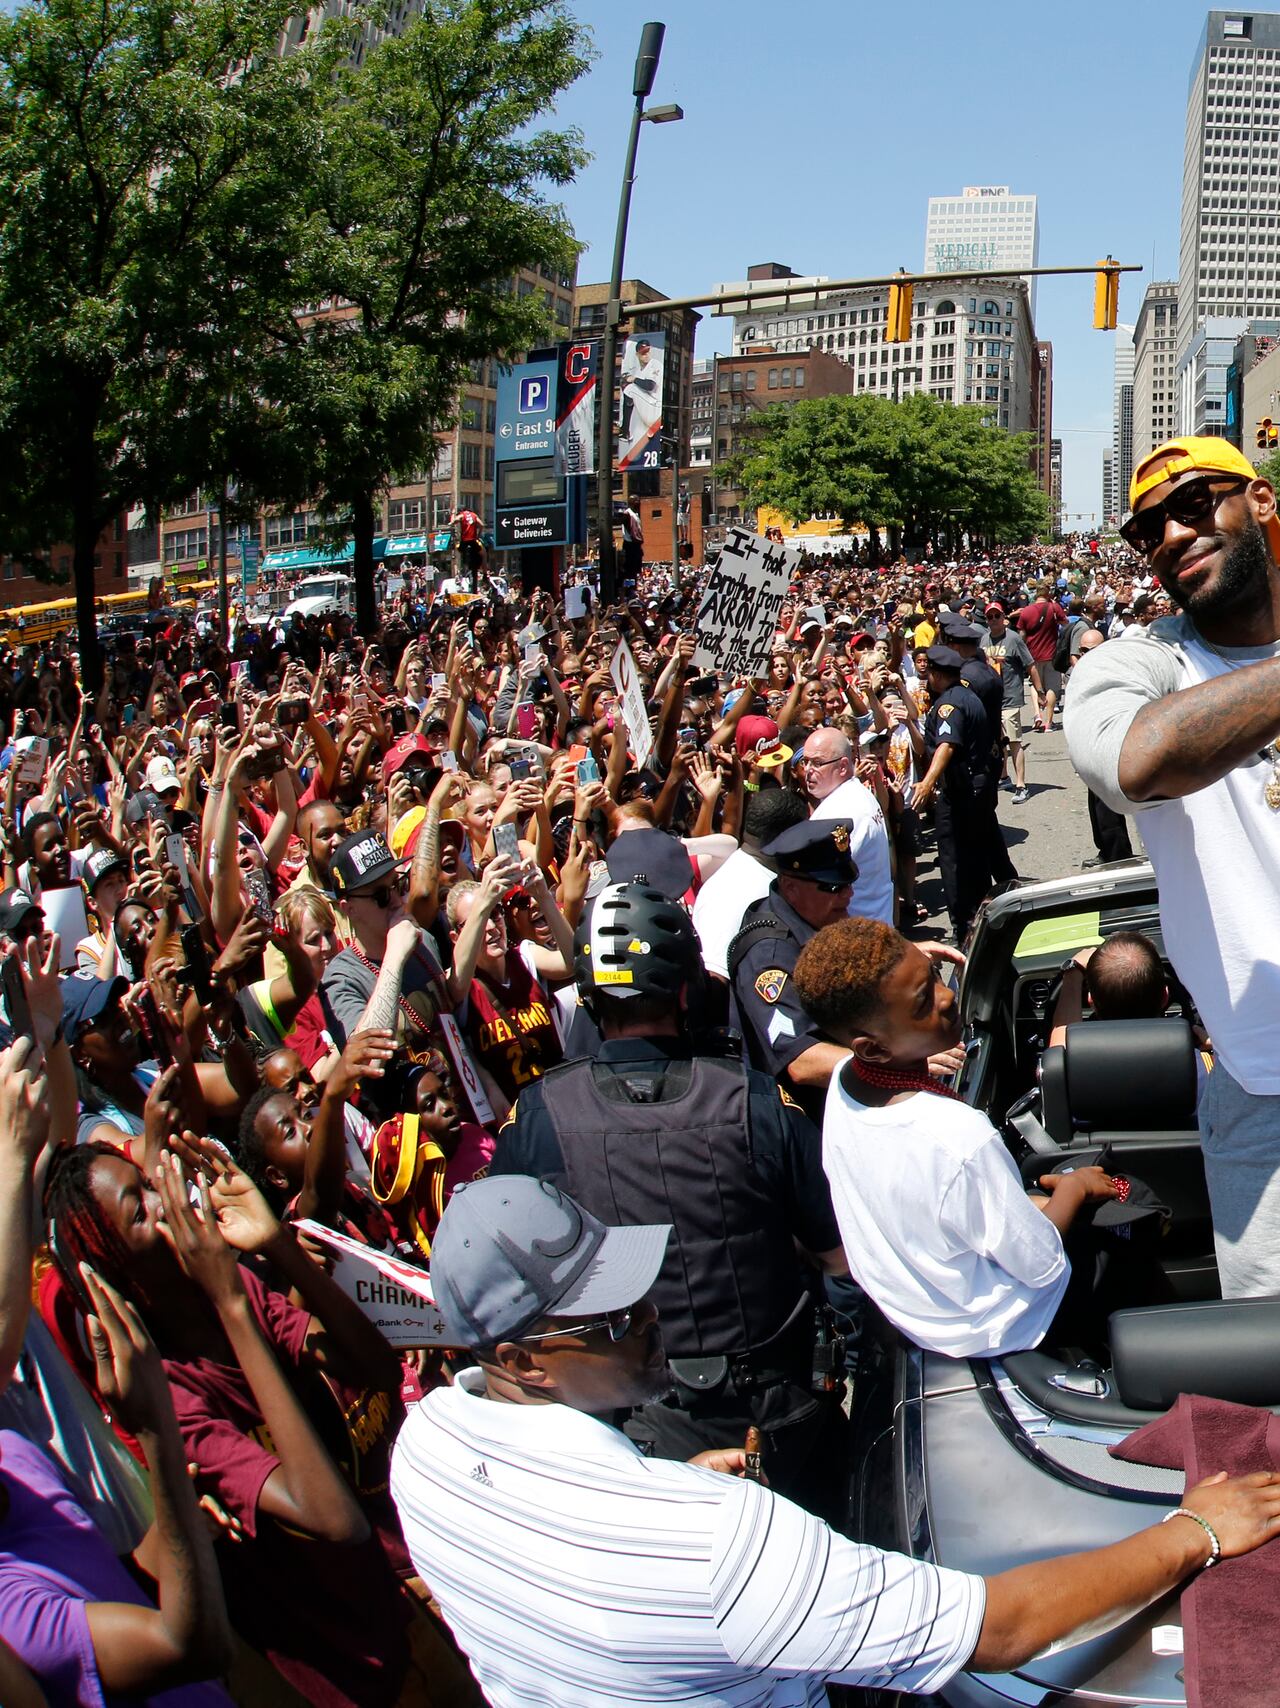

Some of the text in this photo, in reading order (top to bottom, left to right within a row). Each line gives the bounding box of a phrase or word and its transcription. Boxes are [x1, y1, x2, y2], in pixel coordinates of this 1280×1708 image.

[934, 242, 998, 258] MEDICAL
[565, 345, 591, 384] C
[527, 382, 542, 407] P
[516, 423, 542, 437] East
[515, 439, 549, 451] Entrance
[567, 429, 581, 475] KLUBER
[643, 451, 658, 467] 28
[514, 516, 548, 528] Gateway
[514, 528, 553, 539] Deliveries
[723, 529, 760, 560] It
[761, 545, 787, 577] took
[757, 580, 784, 613] from
[697, 591, 775, 639] AKRON to
[730, 629, 750, 656] the
[358, 837, 380, 857] NBA
[603, 973, 622, 981] 2144
